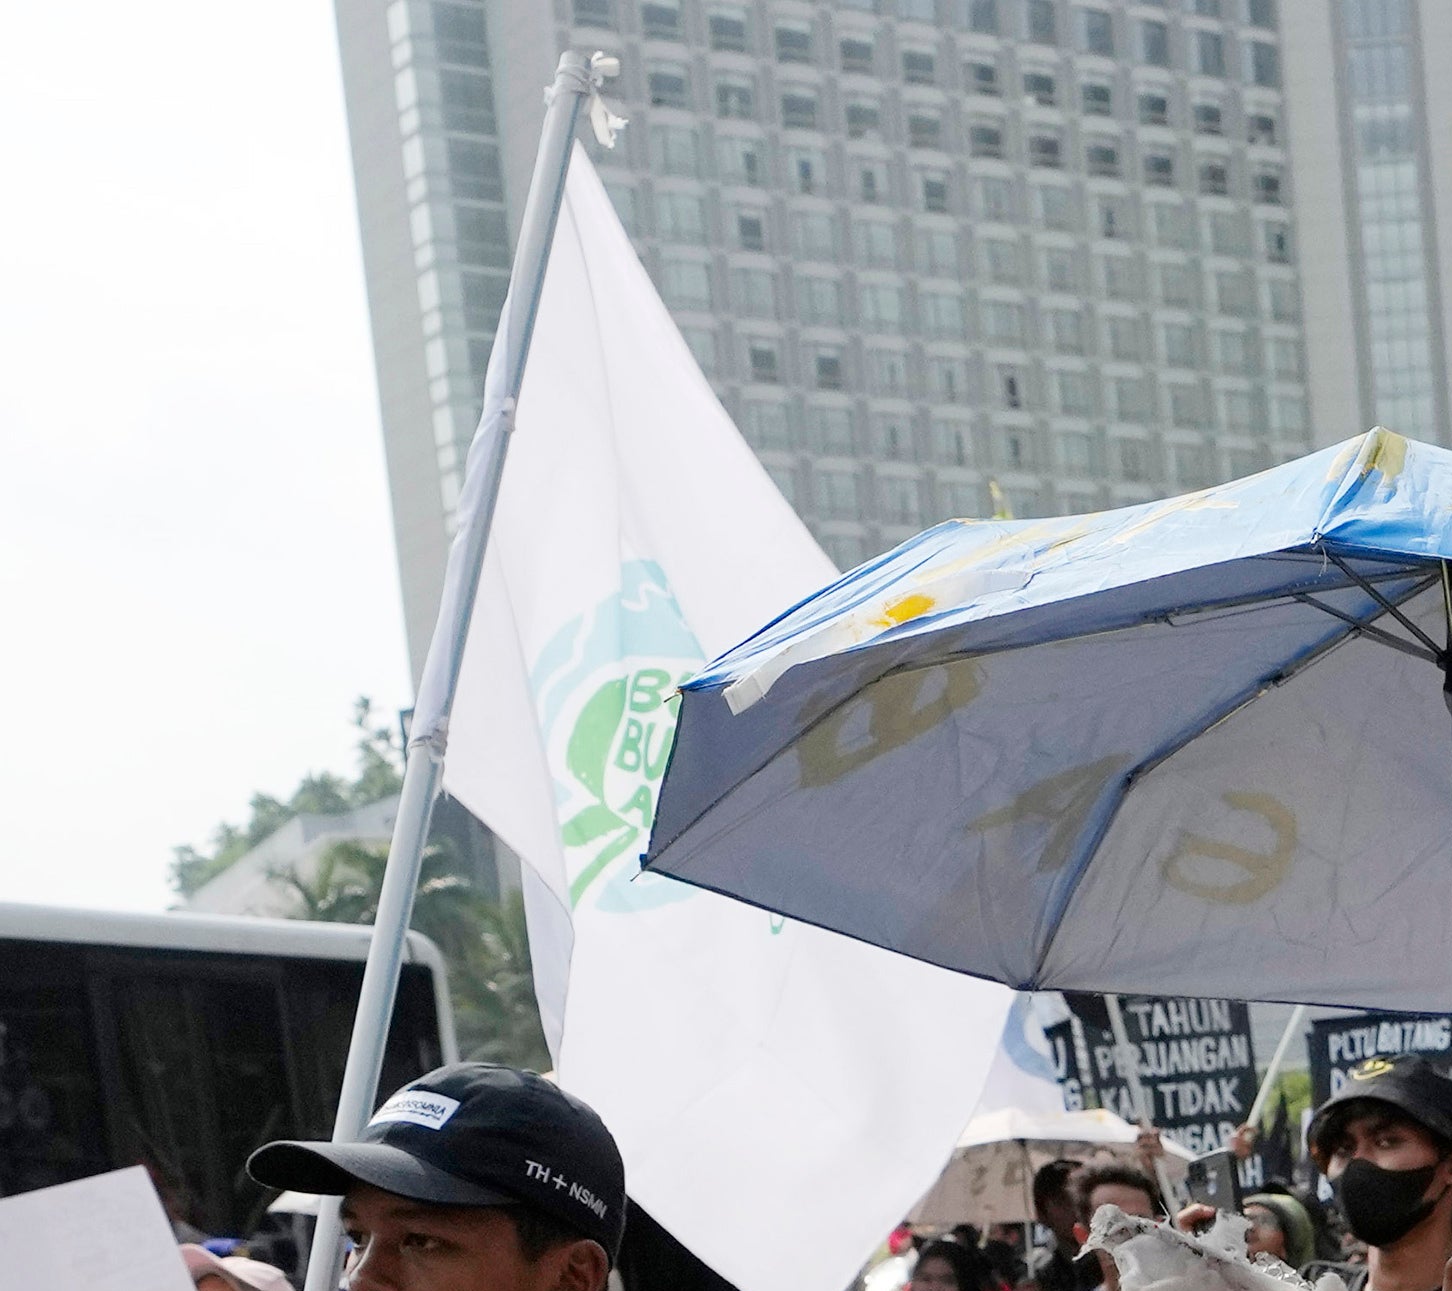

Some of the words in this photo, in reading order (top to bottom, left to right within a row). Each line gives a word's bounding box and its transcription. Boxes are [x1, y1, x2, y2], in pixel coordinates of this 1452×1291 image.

[1127, 999, 1231, 1037] TAHUN
[1157, 1077, 1244, 1120] TIDAK
[525, 1159, 551, 1184] TH
[568, 1181, 609, 1219] NSMN
